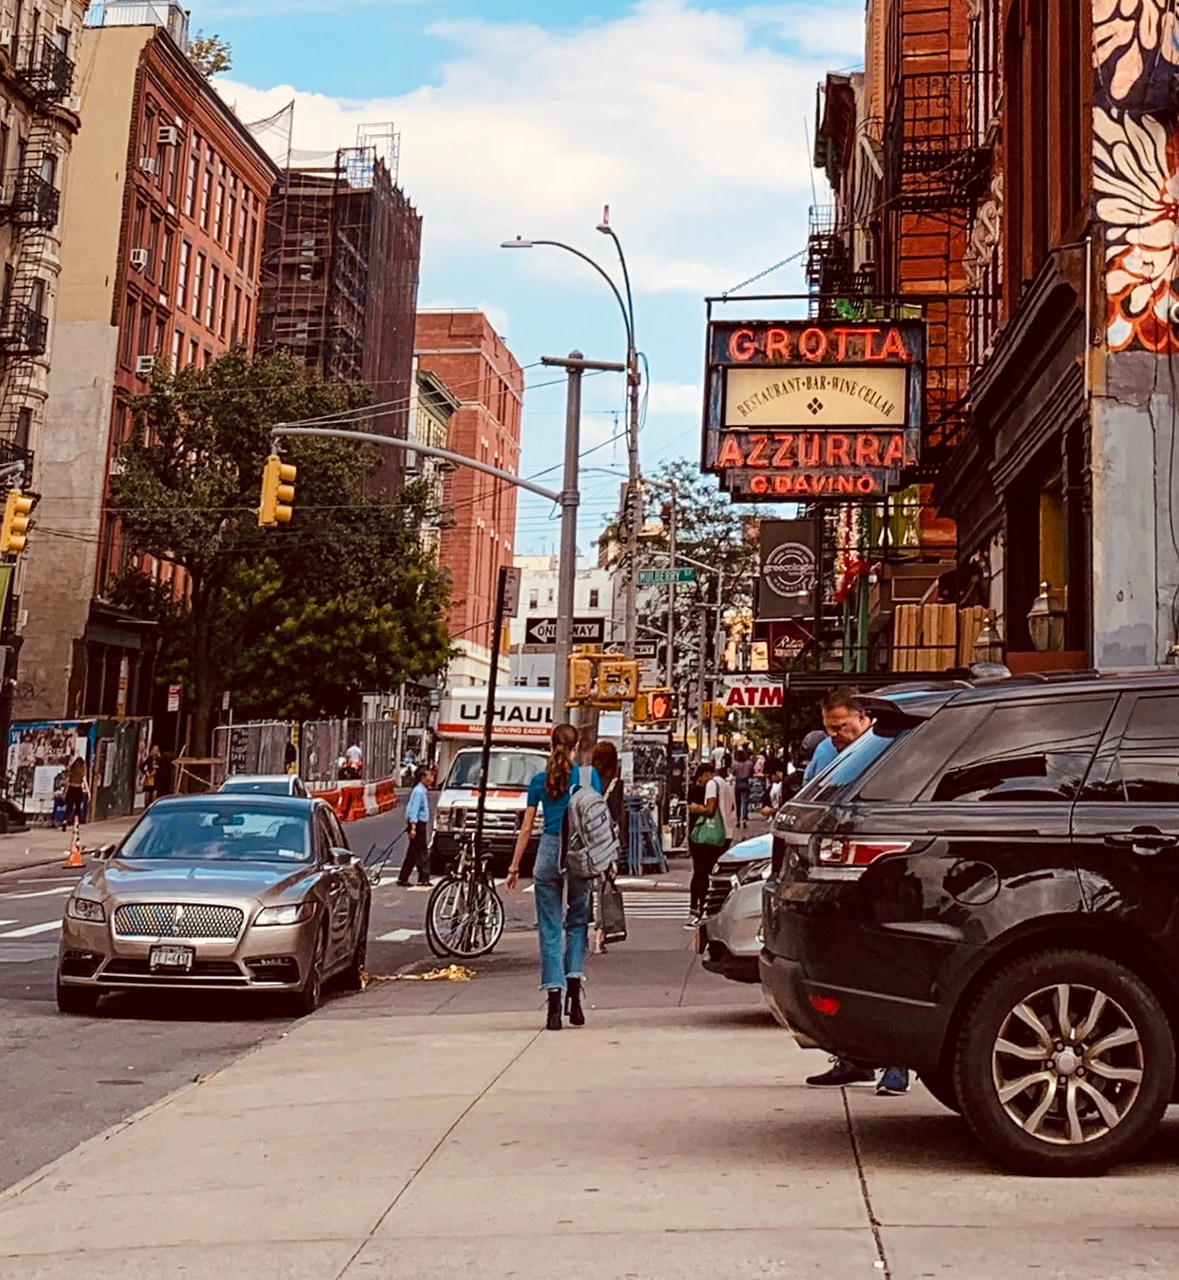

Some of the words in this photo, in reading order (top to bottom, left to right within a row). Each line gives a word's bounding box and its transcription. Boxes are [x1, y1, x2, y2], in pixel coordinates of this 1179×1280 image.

[728, 327, 911, 360] GROTTA
[737, 377, 801, 417] RESTAURANT
[806, 375, 826, 390] BAR
[831, 376, 858, 396] WINE
[857, 385, 896, 418] CELLAR
[717, 433, 915, 468] AZZURRA
[640, 570, 680, 583] MULBERRY
[726, 687, 783, 705] ATM
